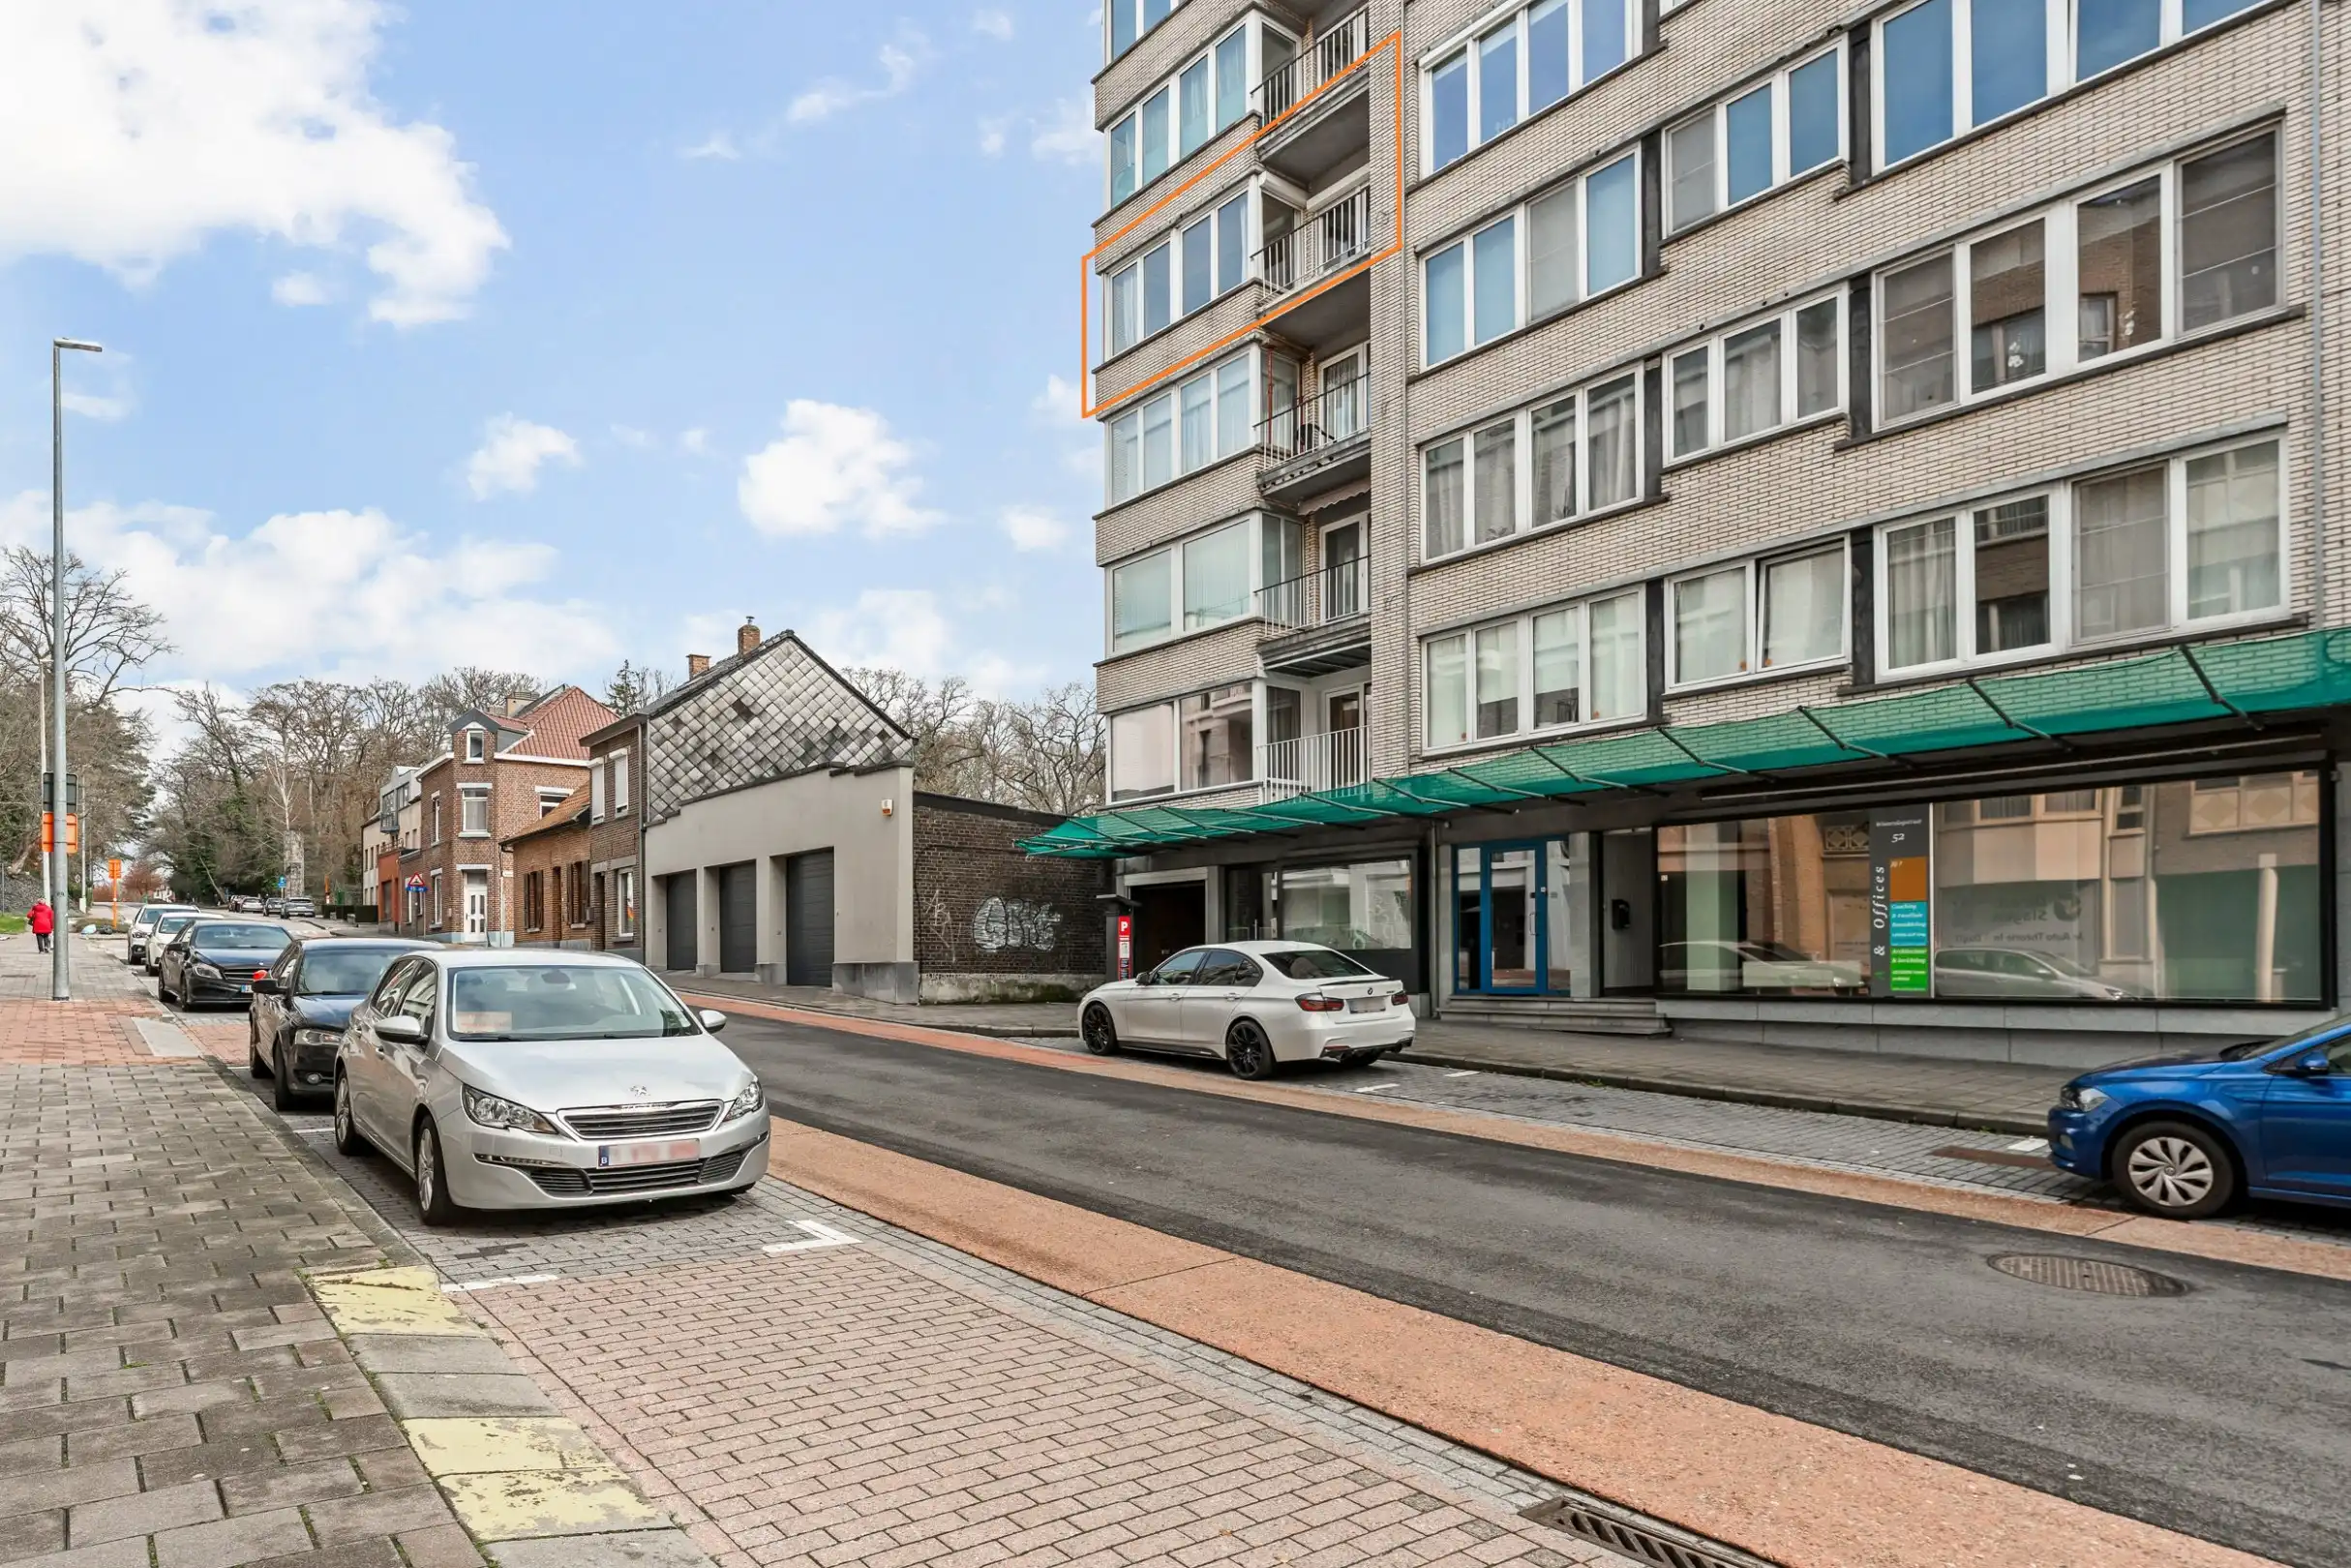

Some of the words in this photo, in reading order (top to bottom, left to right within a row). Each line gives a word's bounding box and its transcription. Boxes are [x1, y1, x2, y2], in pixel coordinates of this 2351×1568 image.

[1891, 832, 1905, 843] 52
[1872, 866, 1888, 929] Offices
[1120, 920, 1129, 932] P
[1873, 945, 1885, 956] &
